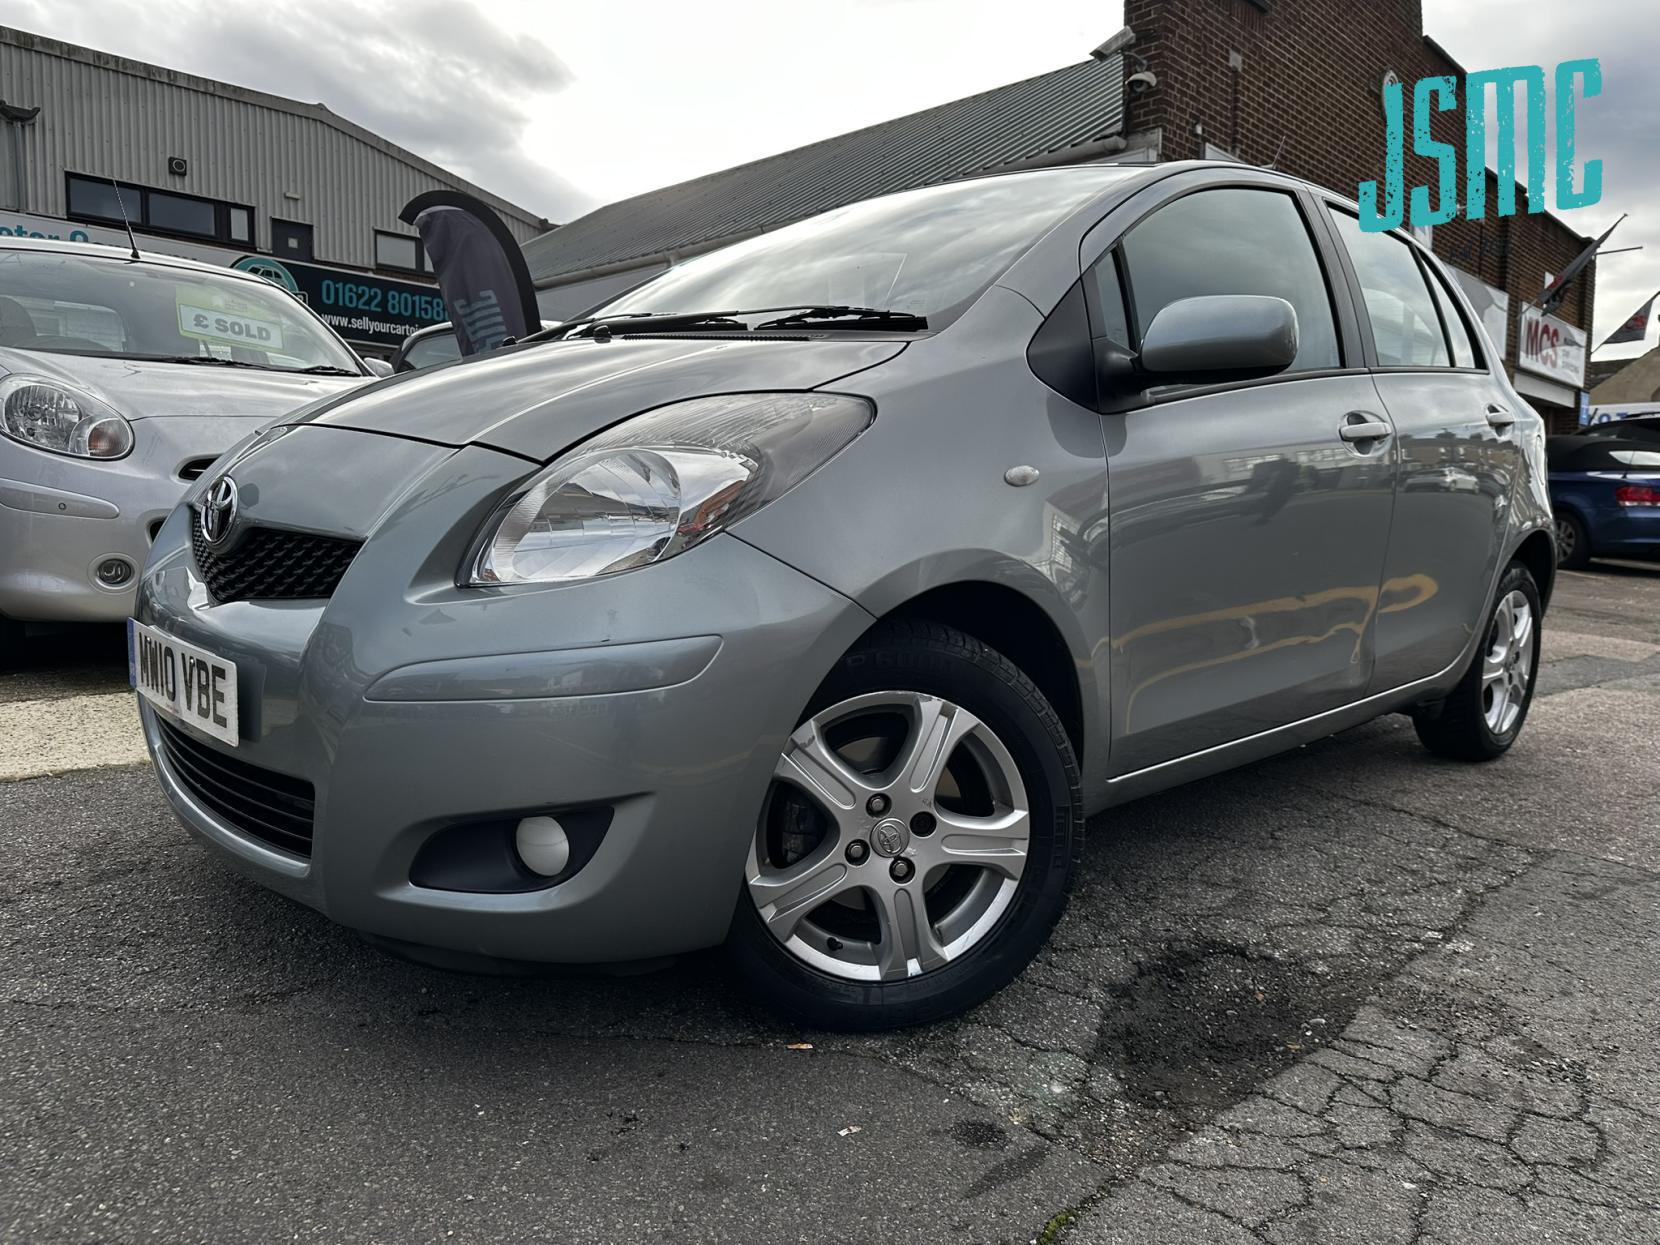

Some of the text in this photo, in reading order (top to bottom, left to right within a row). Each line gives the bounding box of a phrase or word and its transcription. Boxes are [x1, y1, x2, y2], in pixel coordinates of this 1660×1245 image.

[321, 279, 449, 321] 01622 80158
[215, 318, 271, 341] SOLD
[1525, 317, 1559, 369] MCS
[181, 653, 227, 728] VBE
